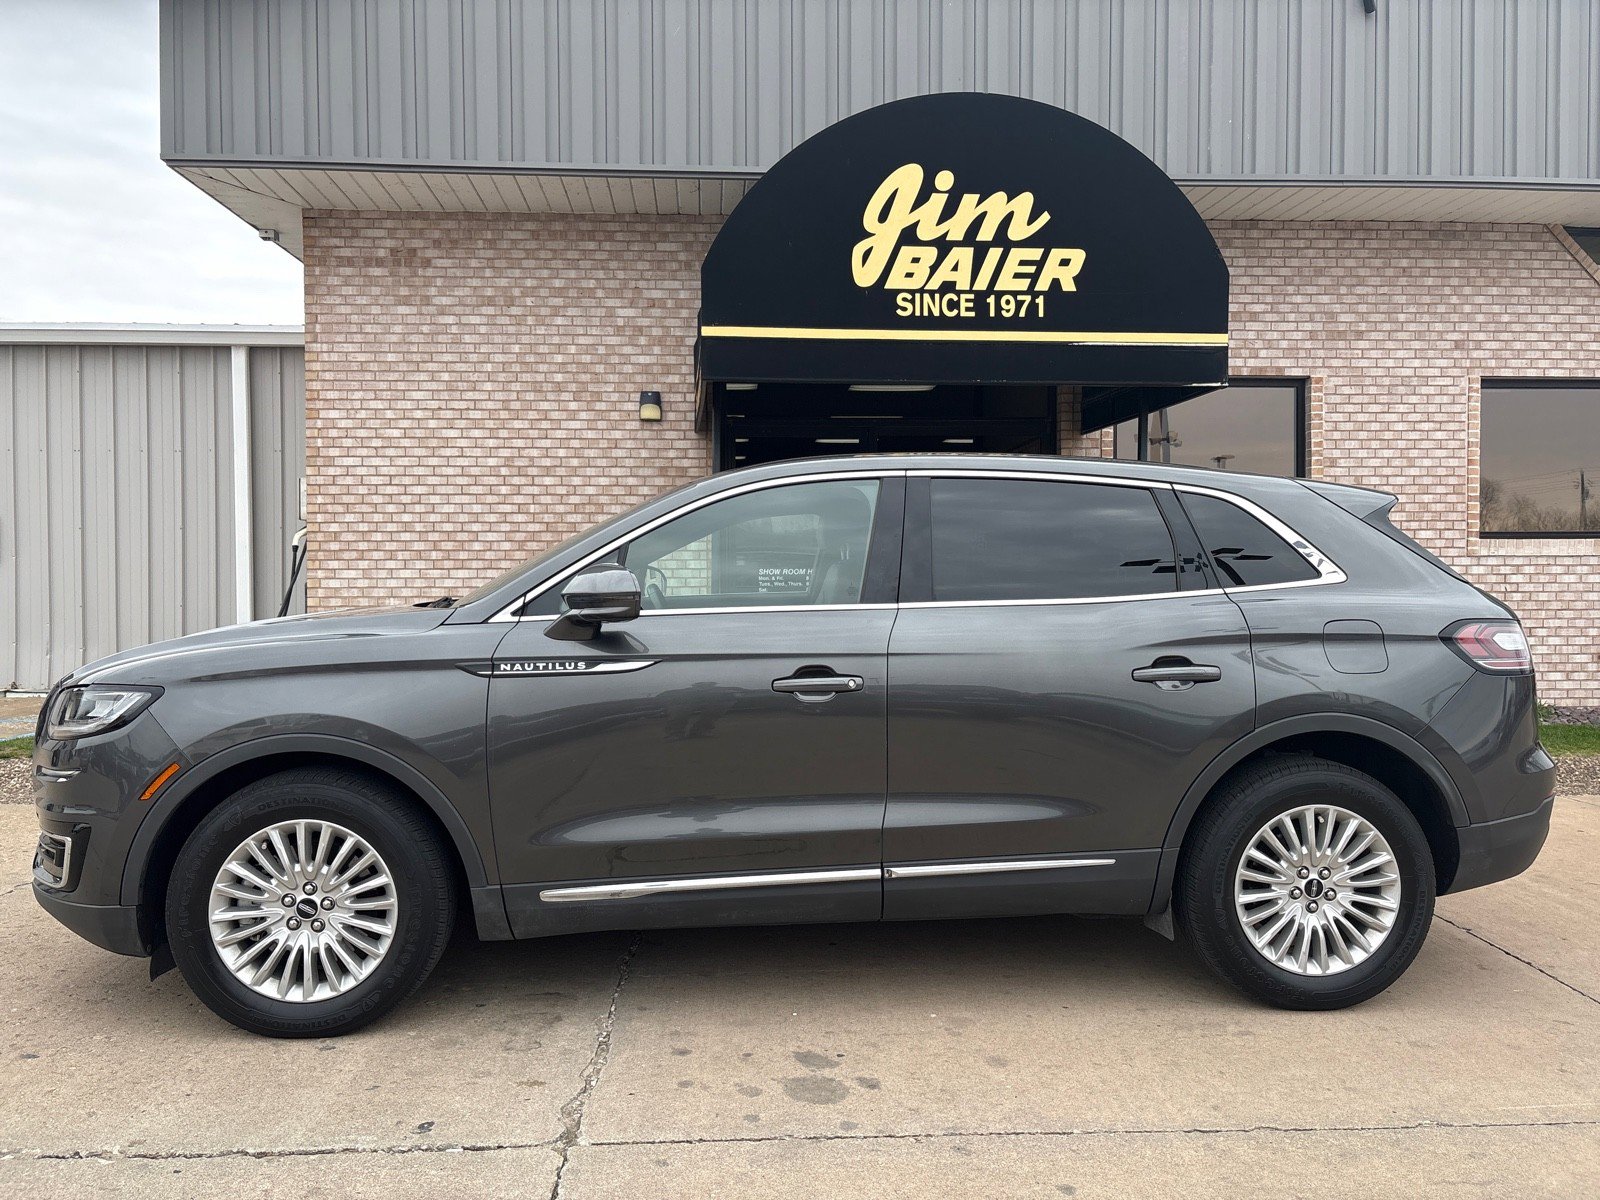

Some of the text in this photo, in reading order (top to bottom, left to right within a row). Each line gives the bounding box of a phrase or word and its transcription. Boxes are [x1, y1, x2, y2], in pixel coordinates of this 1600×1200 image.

[851, 163, 1051, 288] Jim
[883, 246, 1087, 292] BAIER
[896, 292, 1045, 317] SINCE 1971
[500, 661, 586, 671] NAUTILUS
